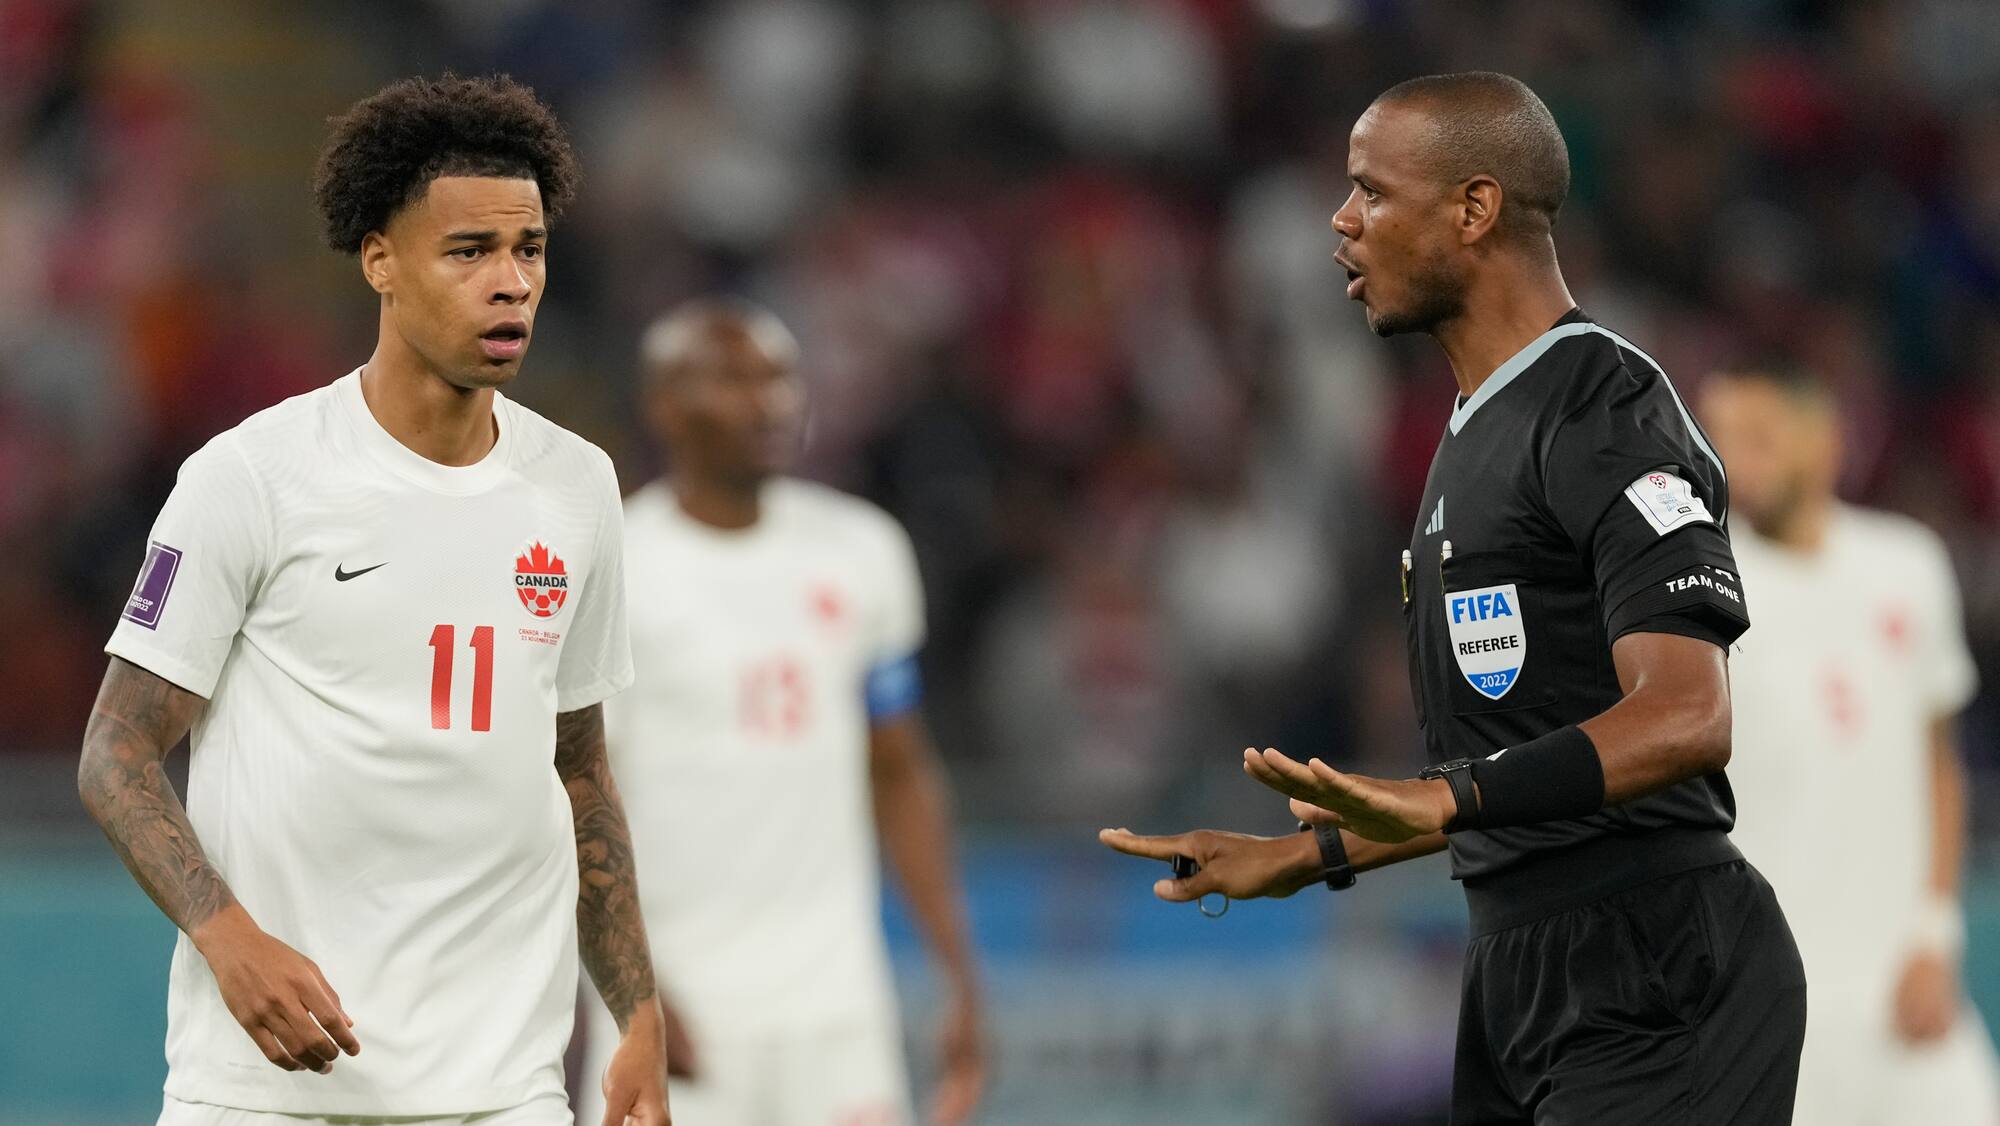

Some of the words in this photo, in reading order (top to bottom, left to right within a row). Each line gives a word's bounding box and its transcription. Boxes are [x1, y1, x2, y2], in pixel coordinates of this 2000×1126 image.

[515, 575, 567, 588] CANADA
[1666, 575, 1713, 593] TEAM
[1715, 582, 1740, 603] ONE
[1452, 592, 1513, 624] FIFA
[1458, 635, 1519, 656] REFEREE
[428, 624, 494, 732] 11
[1480, 673, 1508, 689] 2022
